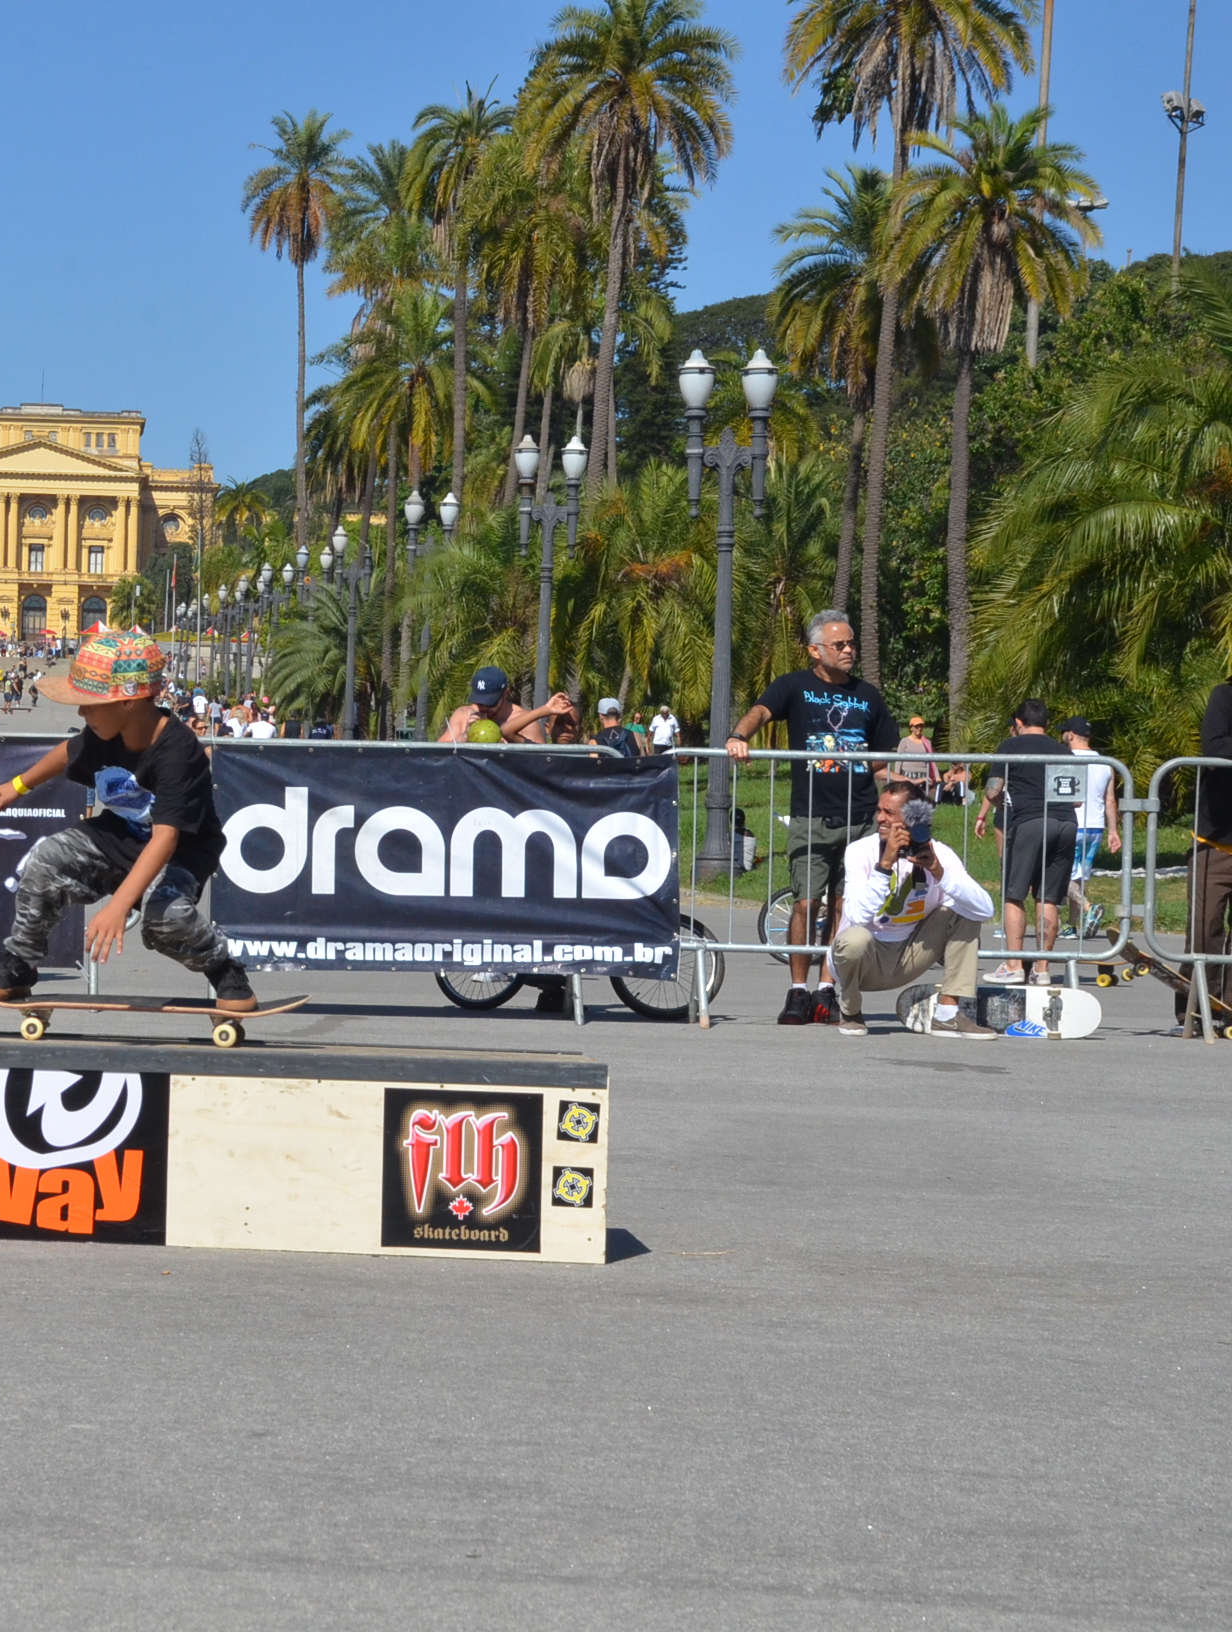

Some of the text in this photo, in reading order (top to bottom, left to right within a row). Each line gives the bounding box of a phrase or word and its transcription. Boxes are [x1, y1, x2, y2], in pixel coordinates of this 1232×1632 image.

[803, 690, 831, 705] Black
[219, 786, 672, 900] drama
[227, 937, 673, 966] www.dramaoriginal.com.br
[1017, 1020, 1047, 1036] NIKE
[413, 1223, 509, 1242] skateboard
